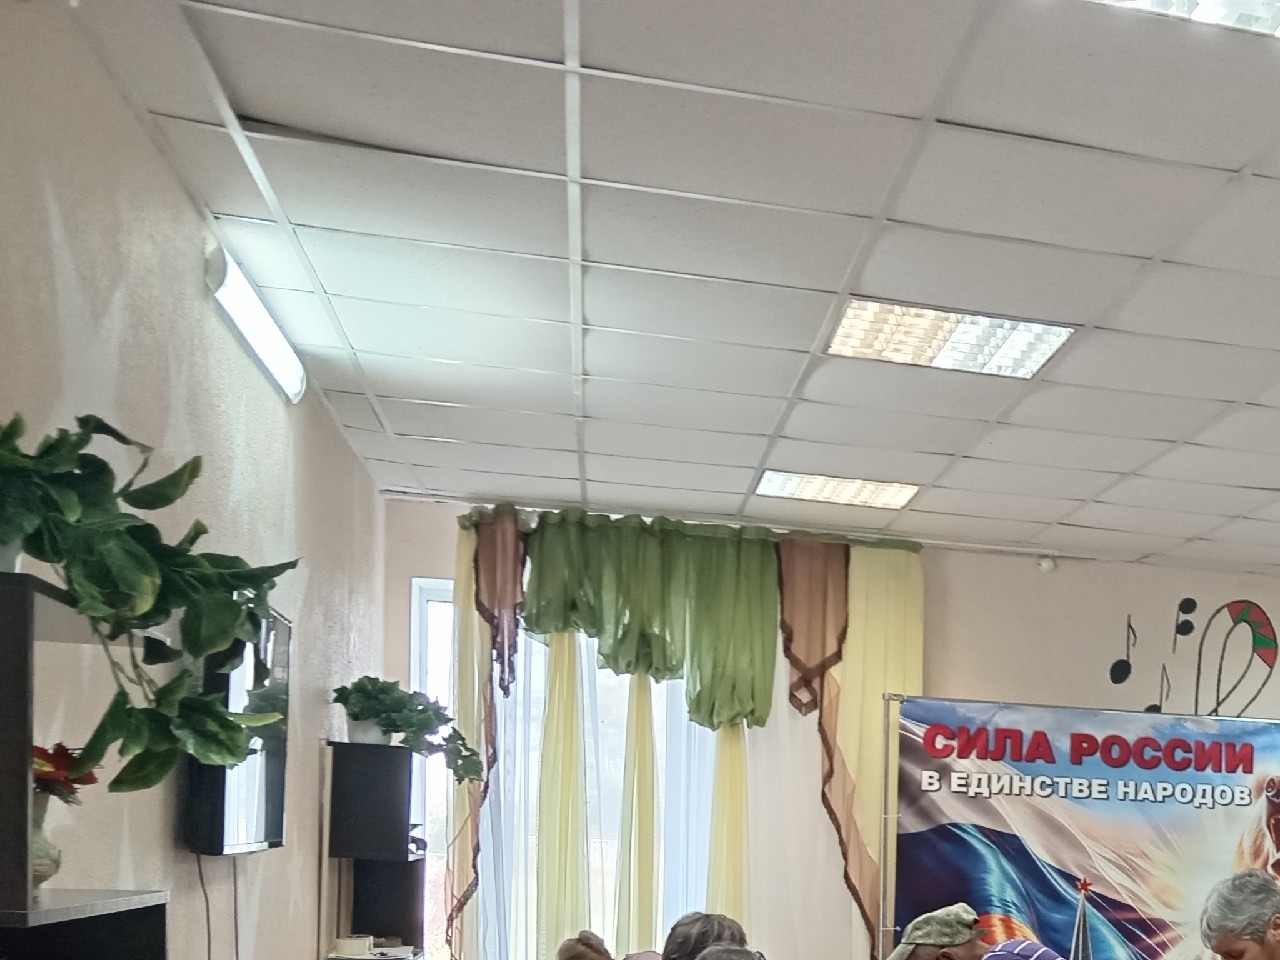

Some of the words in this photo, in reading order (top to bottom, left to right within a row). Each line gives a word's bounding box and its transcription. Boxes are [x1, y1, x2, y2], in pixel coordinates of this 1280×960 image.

[923, 723, 1056, 764] СИЛА
[1069, 732, 1254, 774] РОССИИ
[921, 770, 942, 792] В
[951, 771, 1109, 799] ЕДИНСТВЕ
[1117, 779, 1253, 809] НАРОДОВ
